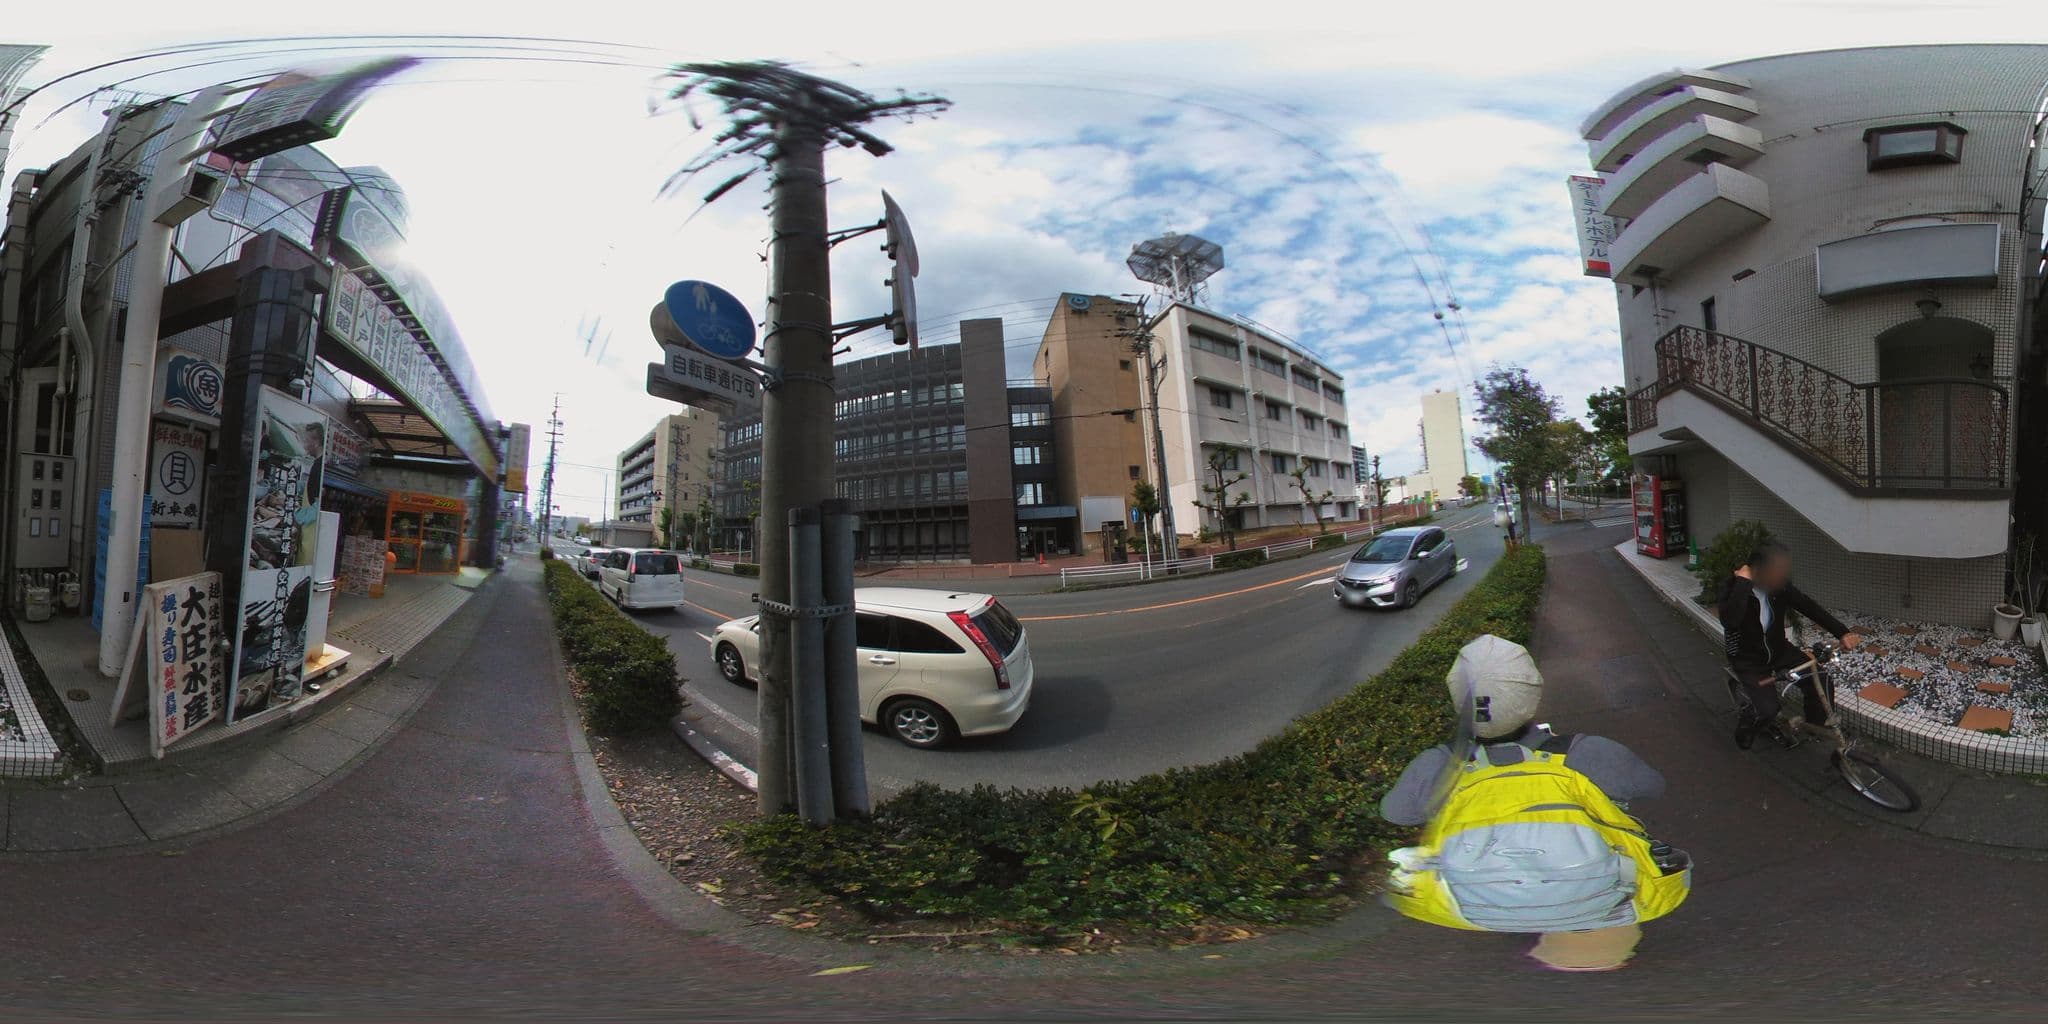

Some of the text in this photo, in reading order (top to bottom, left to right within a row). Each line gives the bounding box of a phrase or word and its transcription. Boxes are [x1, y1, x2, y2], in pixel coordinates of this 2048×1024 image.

[1578, 183, 1614, 258] ターミナルホテル
[356, 309, 372, 343] 八戸
[197, 371, 220, 399] 魚
[673, 355, 756, 399] 自転車通行可
[181, 586, 209, 731] 大庄水産
